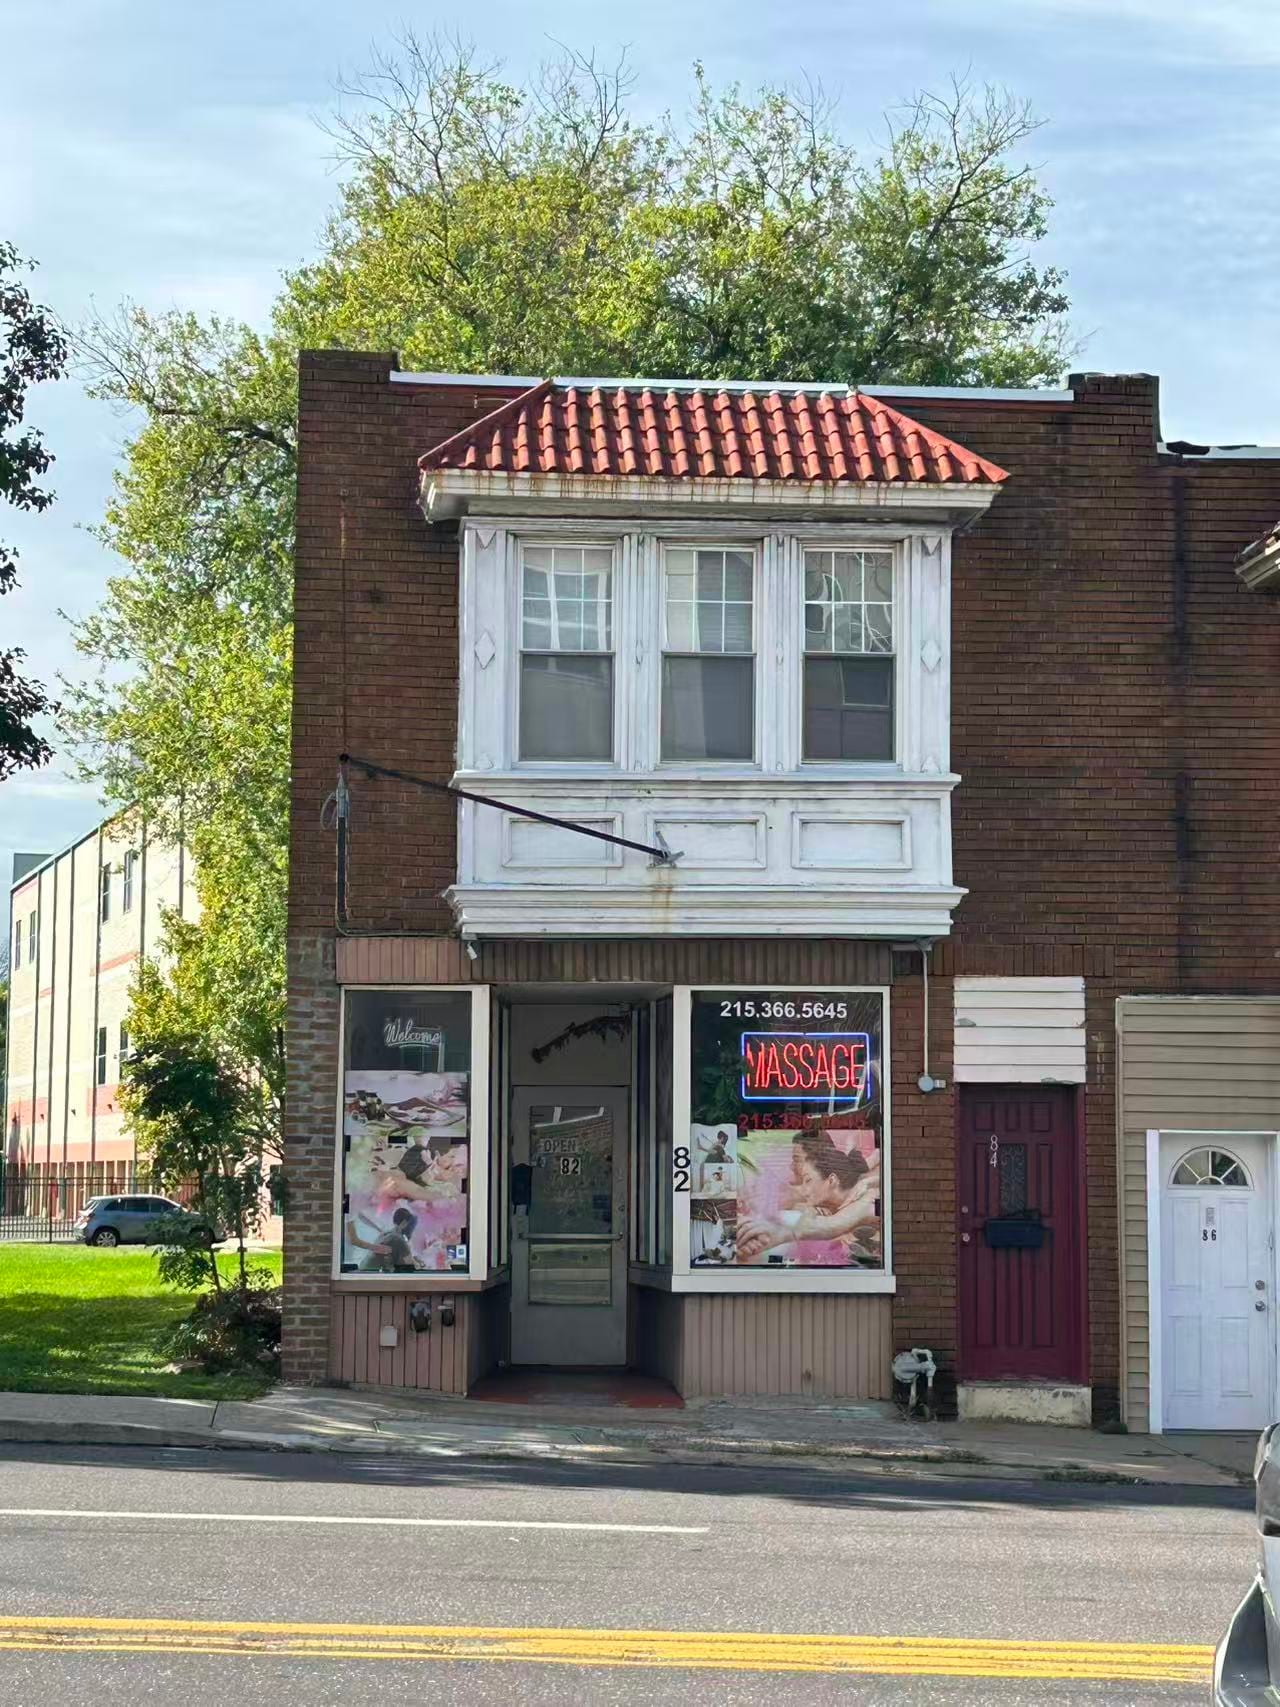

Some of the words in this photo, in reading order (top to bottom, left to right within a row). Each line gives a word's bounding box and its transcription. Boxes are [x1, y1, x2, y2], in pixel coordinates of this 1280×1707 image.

[720, 1001, 847, 1019] 215.366.5645
[384, 1018, 441, 1044] Welcome
[746, 1042, 865, 1089] MASSAGE
[544, 1139, 577, 1152] OPEN
[561, 1158, 580, 1175] 82
[673, 1146, 691, 1192] 82
[1202, 1229, 1217, 1241] 86
